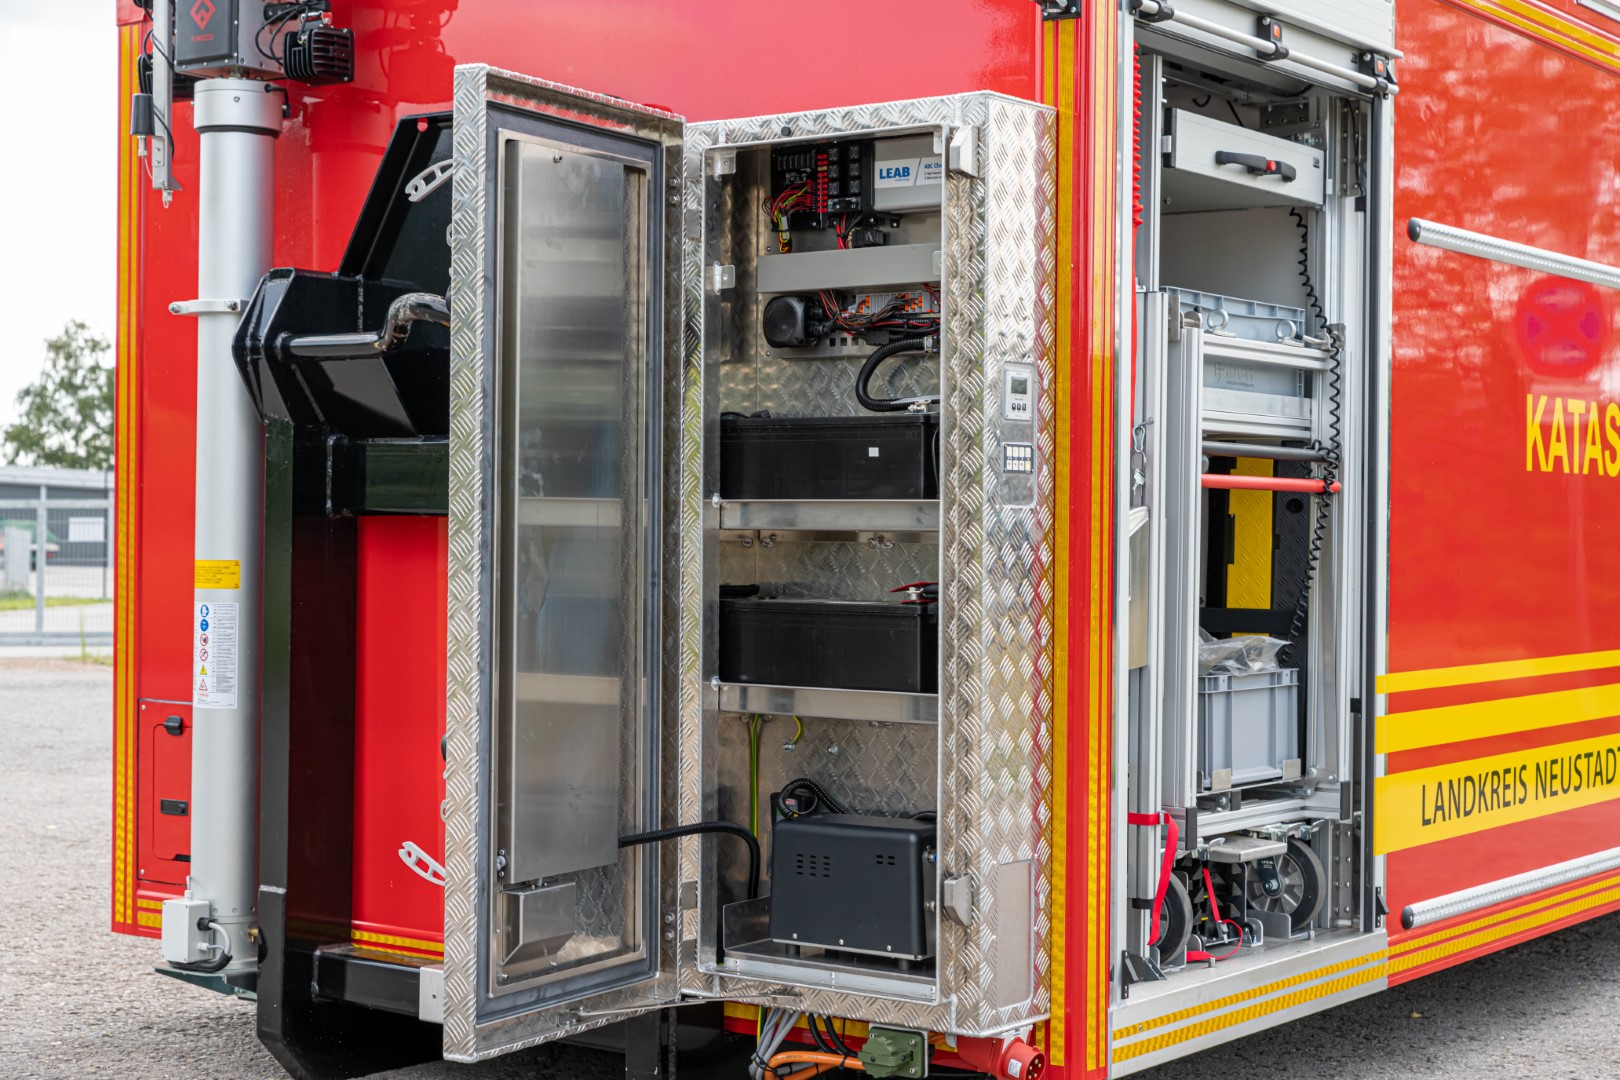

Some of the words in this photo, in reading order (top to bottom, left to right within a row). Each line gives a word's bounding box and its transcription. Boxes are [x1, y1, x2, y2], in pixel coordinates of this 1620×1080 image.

[879, 166, 910, 180] LEAB
[1526, 393, 1620, 478] KATAS
[1421, 764, 1528, 826] LANDKREIS
[1535, 746, 1620, 801] NEUSTAD
